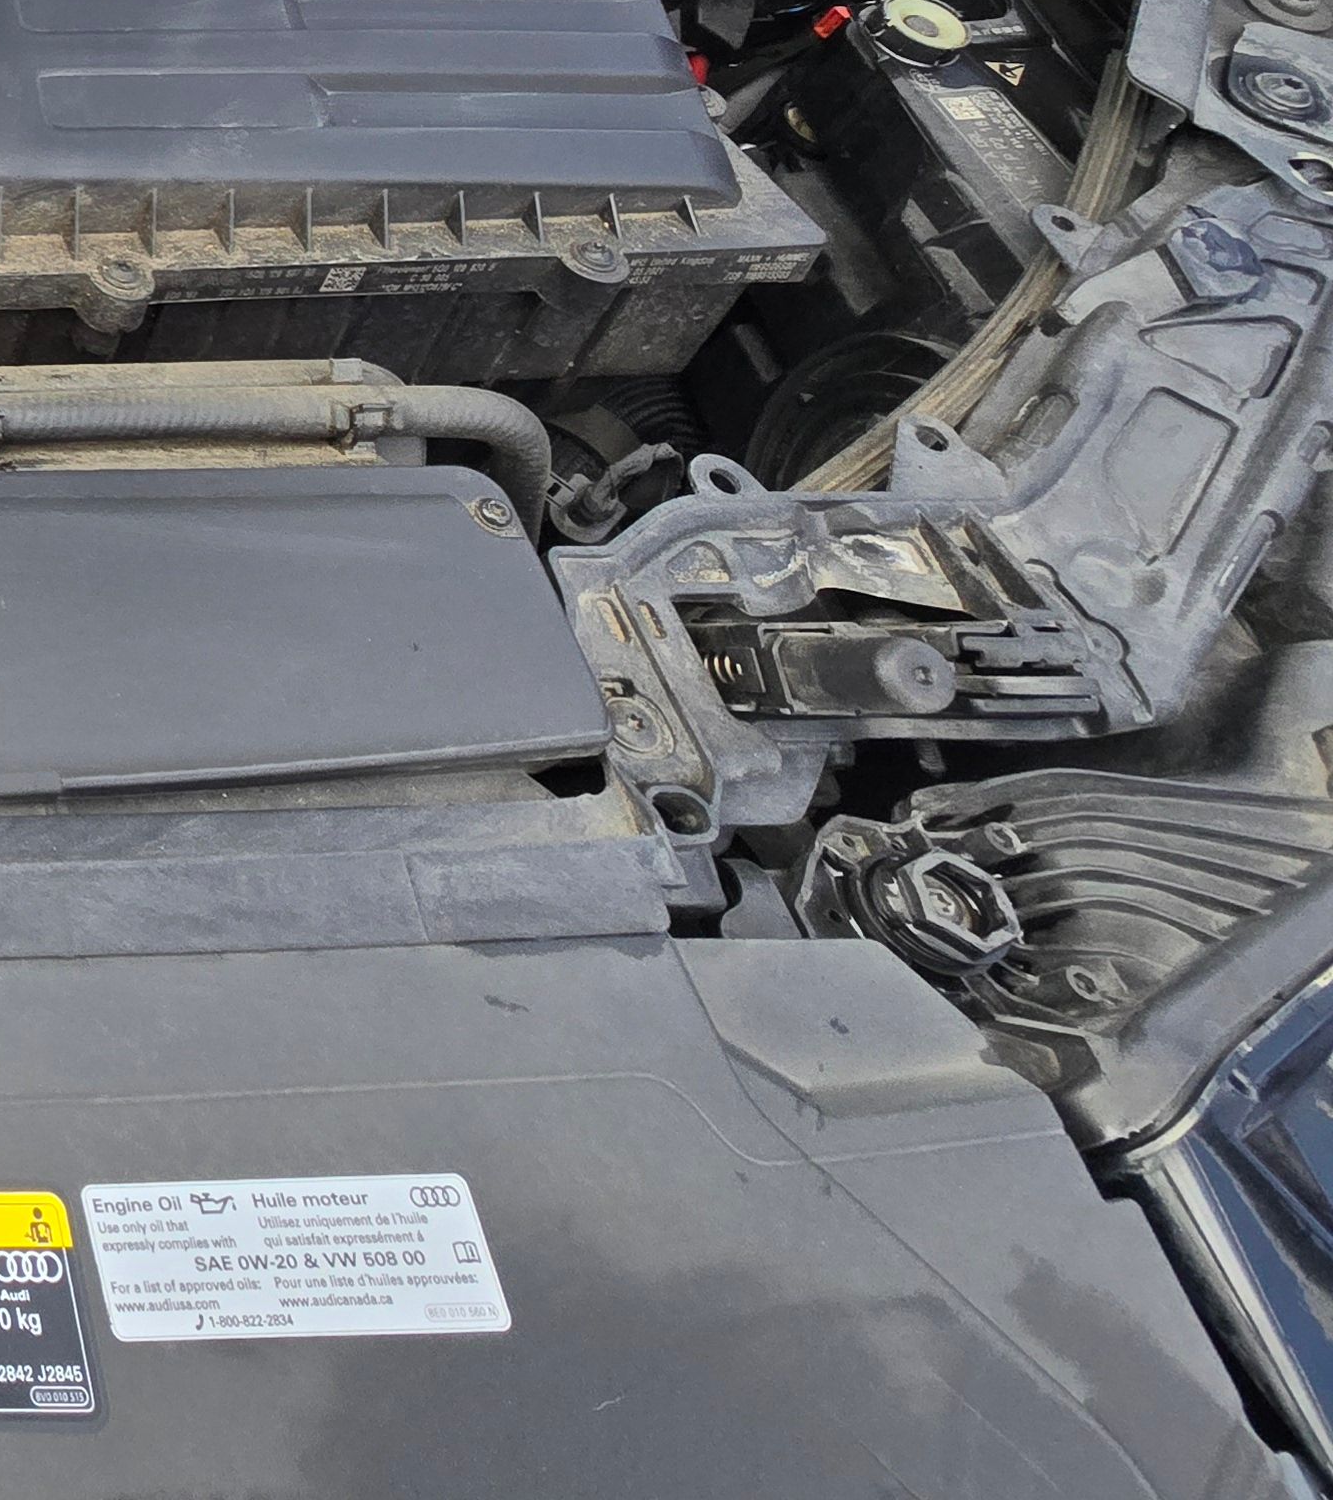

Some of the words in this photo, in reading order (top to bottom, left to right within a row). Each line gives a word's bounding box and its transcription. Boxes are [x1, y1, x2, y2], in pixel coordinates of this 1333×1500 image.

[93, 1196, 153, 1215] Engine
[159, 1195, 182, 1211] Oil
[252, 1191, 298, 1209] Huile
[302, 1192, 368, 1207] moteur
[97, 1222, 119, 1234] Use
[123, 1221, 147, 1235] only
[150, 1221, 164, 1232] oil
[166, 1220, 189, 1232] that
[258, 1216, 300, 1229] Utilisez
[303, 1213, 372, 1230] uniquement
[375, 1213, 390, 1226] de
[392, 1212, 428, 1225] l'huile
[102, 1239, 155, 1254] expressly
[158, 1236, 210, 1251] complies
[211, 1235, 237, 1249] with
[264, 1234, 283, 1249] qui
[285, 1233, 331, 1247] satisfait
[333, 1231, 408, 1247] expressément
[195, 1255, 234, 1272] SAE
[238, 1253, 299, 1271] 0W-20
[304, 1252, 319, 1269] &
[322, 1251, 357, 1268] VW
[362, 1250, 398, 1267] 508
[401, 1249, 427, 1266] 00
[110, 1281, 131, 1294] For
[134, 1284, 141, 1293] a
[144, 1281, 162, 1293] list
[164, 1280, 175, 1293] of
[179, 1278, 234, 1294] approved
[237, 1279, 261, 1291] oils:
[274, 1277, 302, 1289] Pour
[304, 1278, 327, 1288] une
[330, 1274, 355, 1287] liste
[357, 1272, 404, 1286] d'huiles
[407, 1272, 479, 1287] approuvées:
[0, 1289, 31, 1302] Audi
[279, 1294, 394, 1308] www.audicanada.ca
[115, 1299, 220, 1312] www.audiusa.com
[448, 1307, 466, 1318] 010
[18, 1307, 43, 1335] kg
[208, 1313, 295, 1329] 1-800-822-2834
[37, 1363, 83, 1382] J2845
[53, 1391, 68, 1402] 010
[70, 1391, 84, 1402] 515
